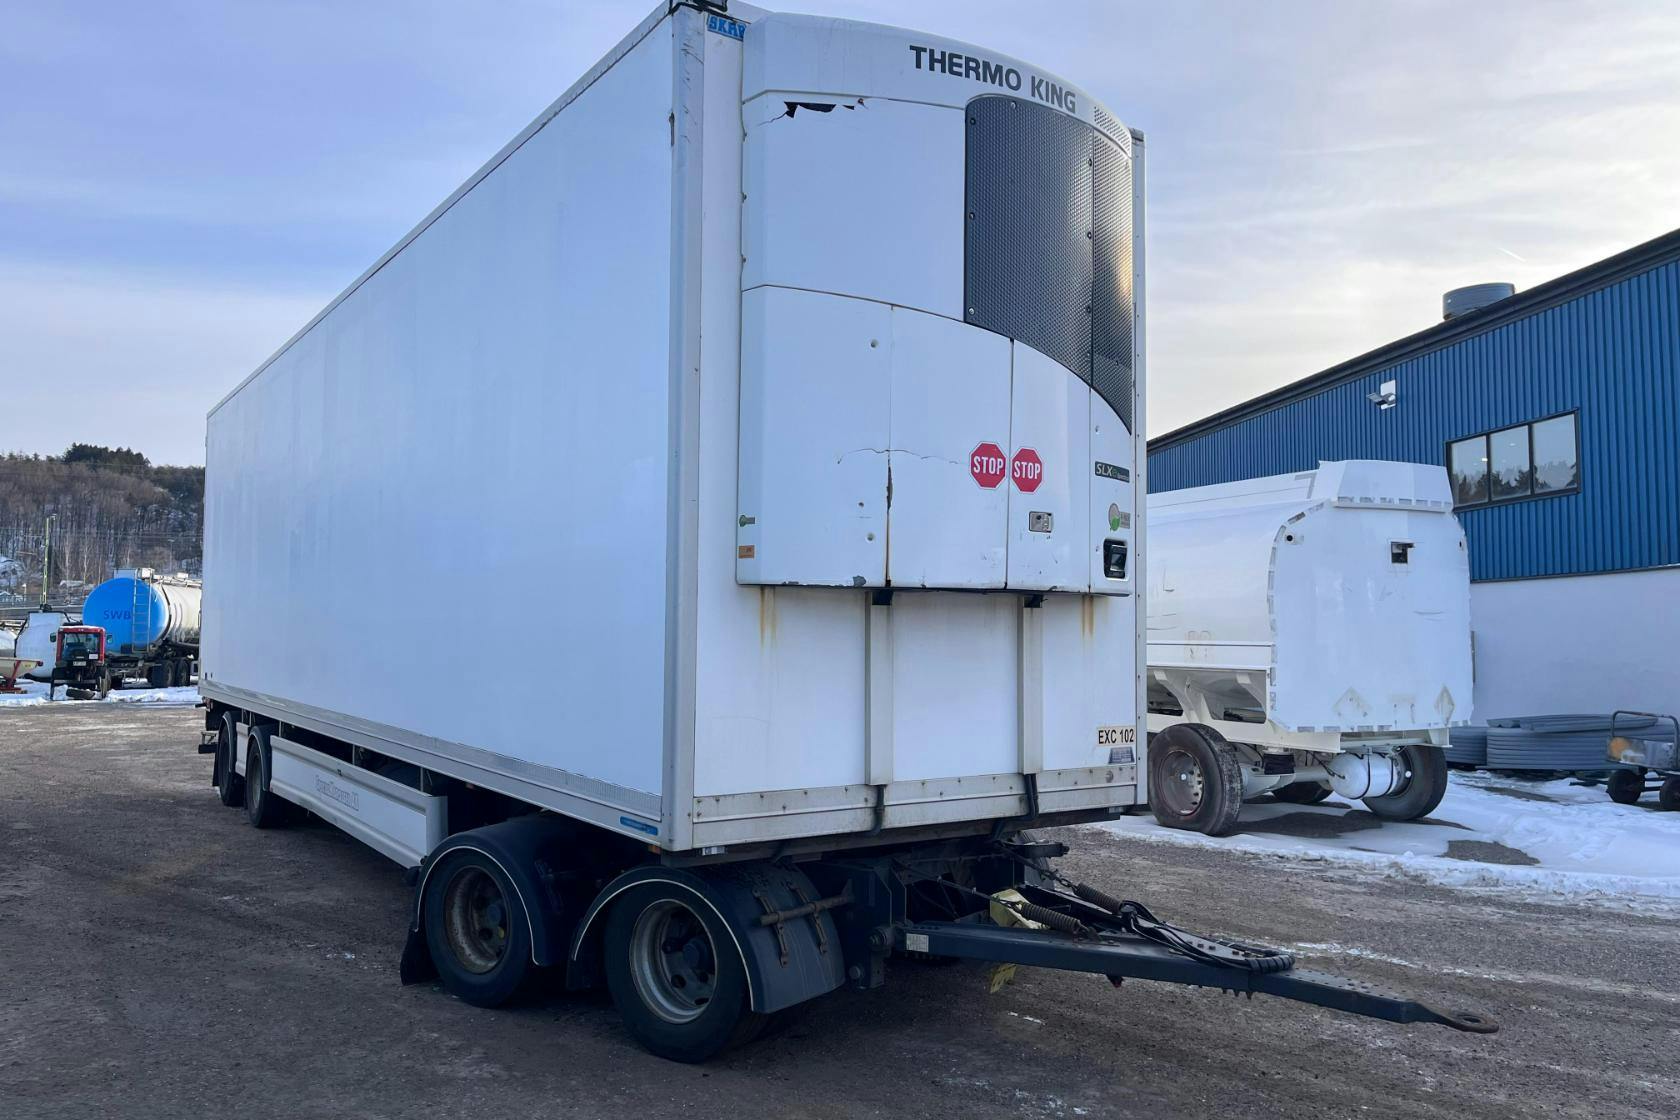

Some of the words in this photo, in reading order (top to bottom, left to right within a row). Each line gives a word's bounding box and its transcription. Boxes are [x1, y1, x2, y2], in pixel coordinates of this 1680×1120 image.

[909, 45, 1022, 91] THERMO
[1031, 75, 1076, 114] KING
[973, 456, 1004, 475] STOP
[1014, 460, 1041, 479] STOP
[103, 610, 131, 620] SWB
[1098, 729, 1117, 744] EXC
[1119, 728, 1134, 743] 102
